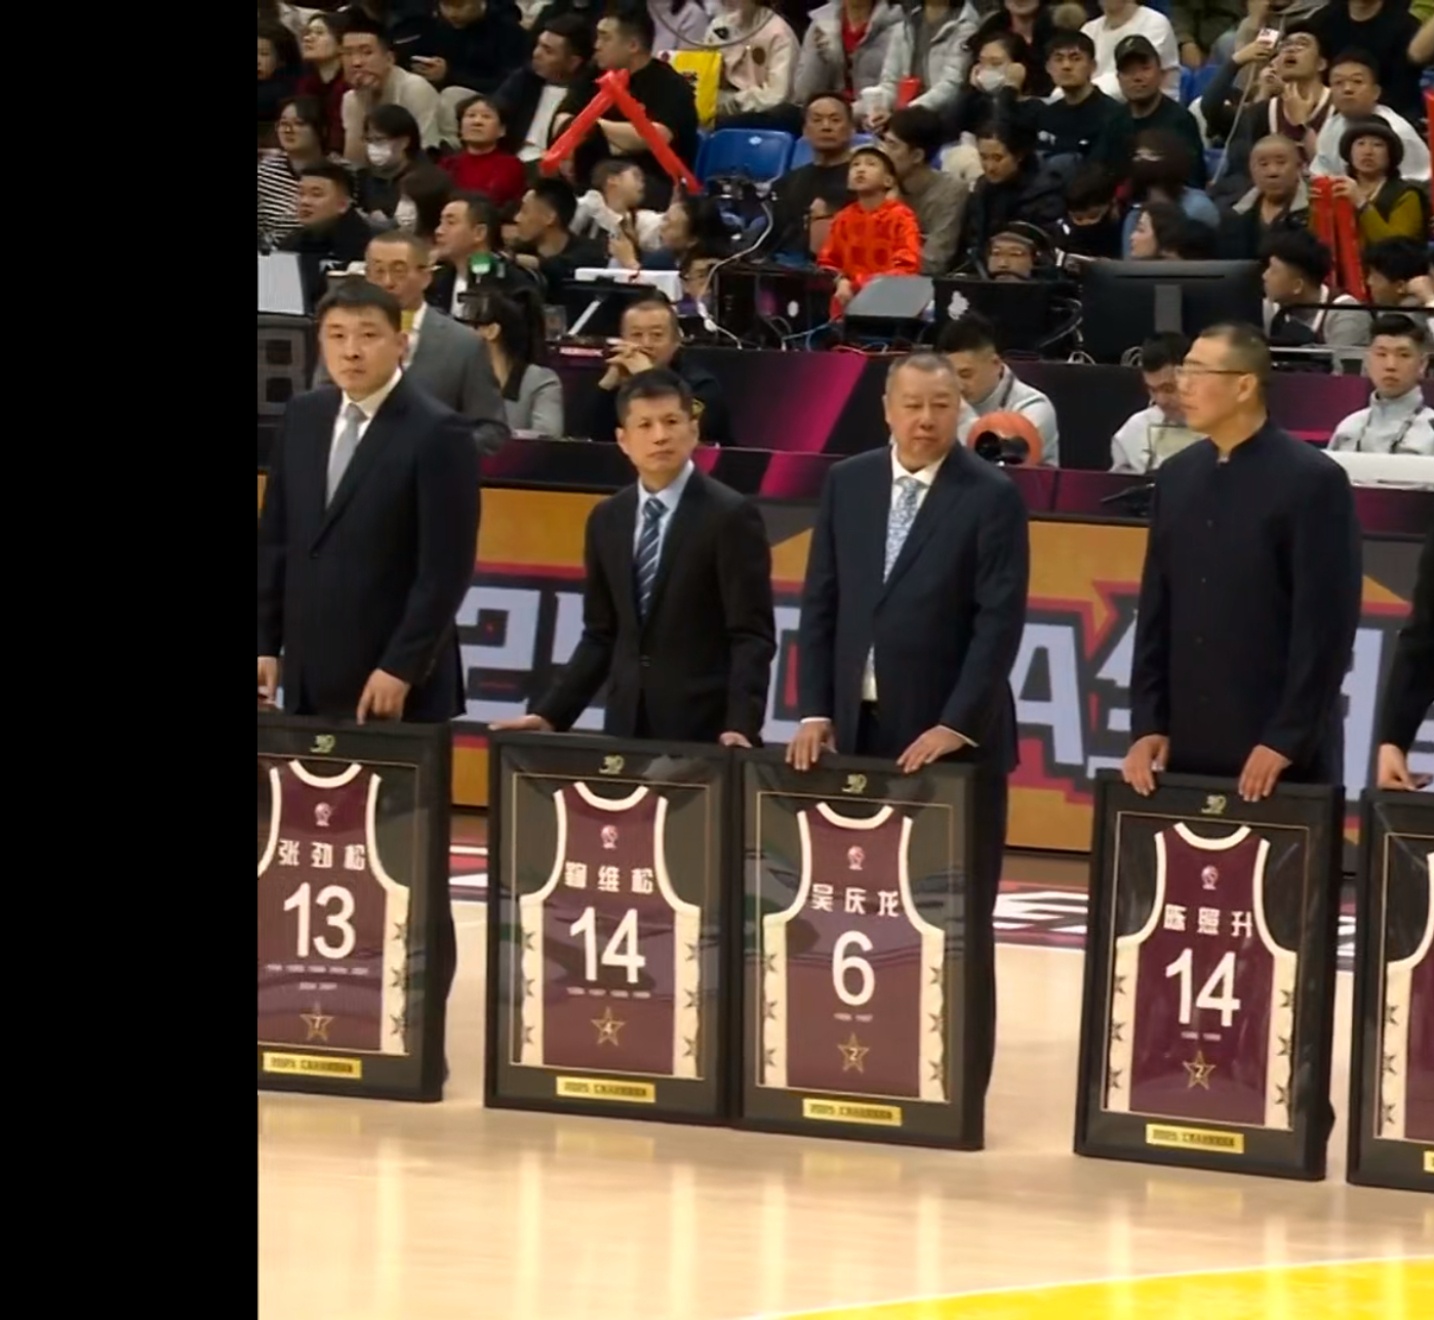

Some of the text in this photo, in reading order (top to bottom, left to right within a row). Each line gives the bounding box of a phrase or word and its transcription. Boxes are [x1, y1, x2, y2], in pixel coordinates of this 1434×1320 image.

[285, 883, 354, 958] 13
[811, 884, 899, 917] 吴庆龙
[571, 907, 645, 983] 14
[833, 931, 874, 1005] 6
[1167, 949, 1239, 1026] 14
